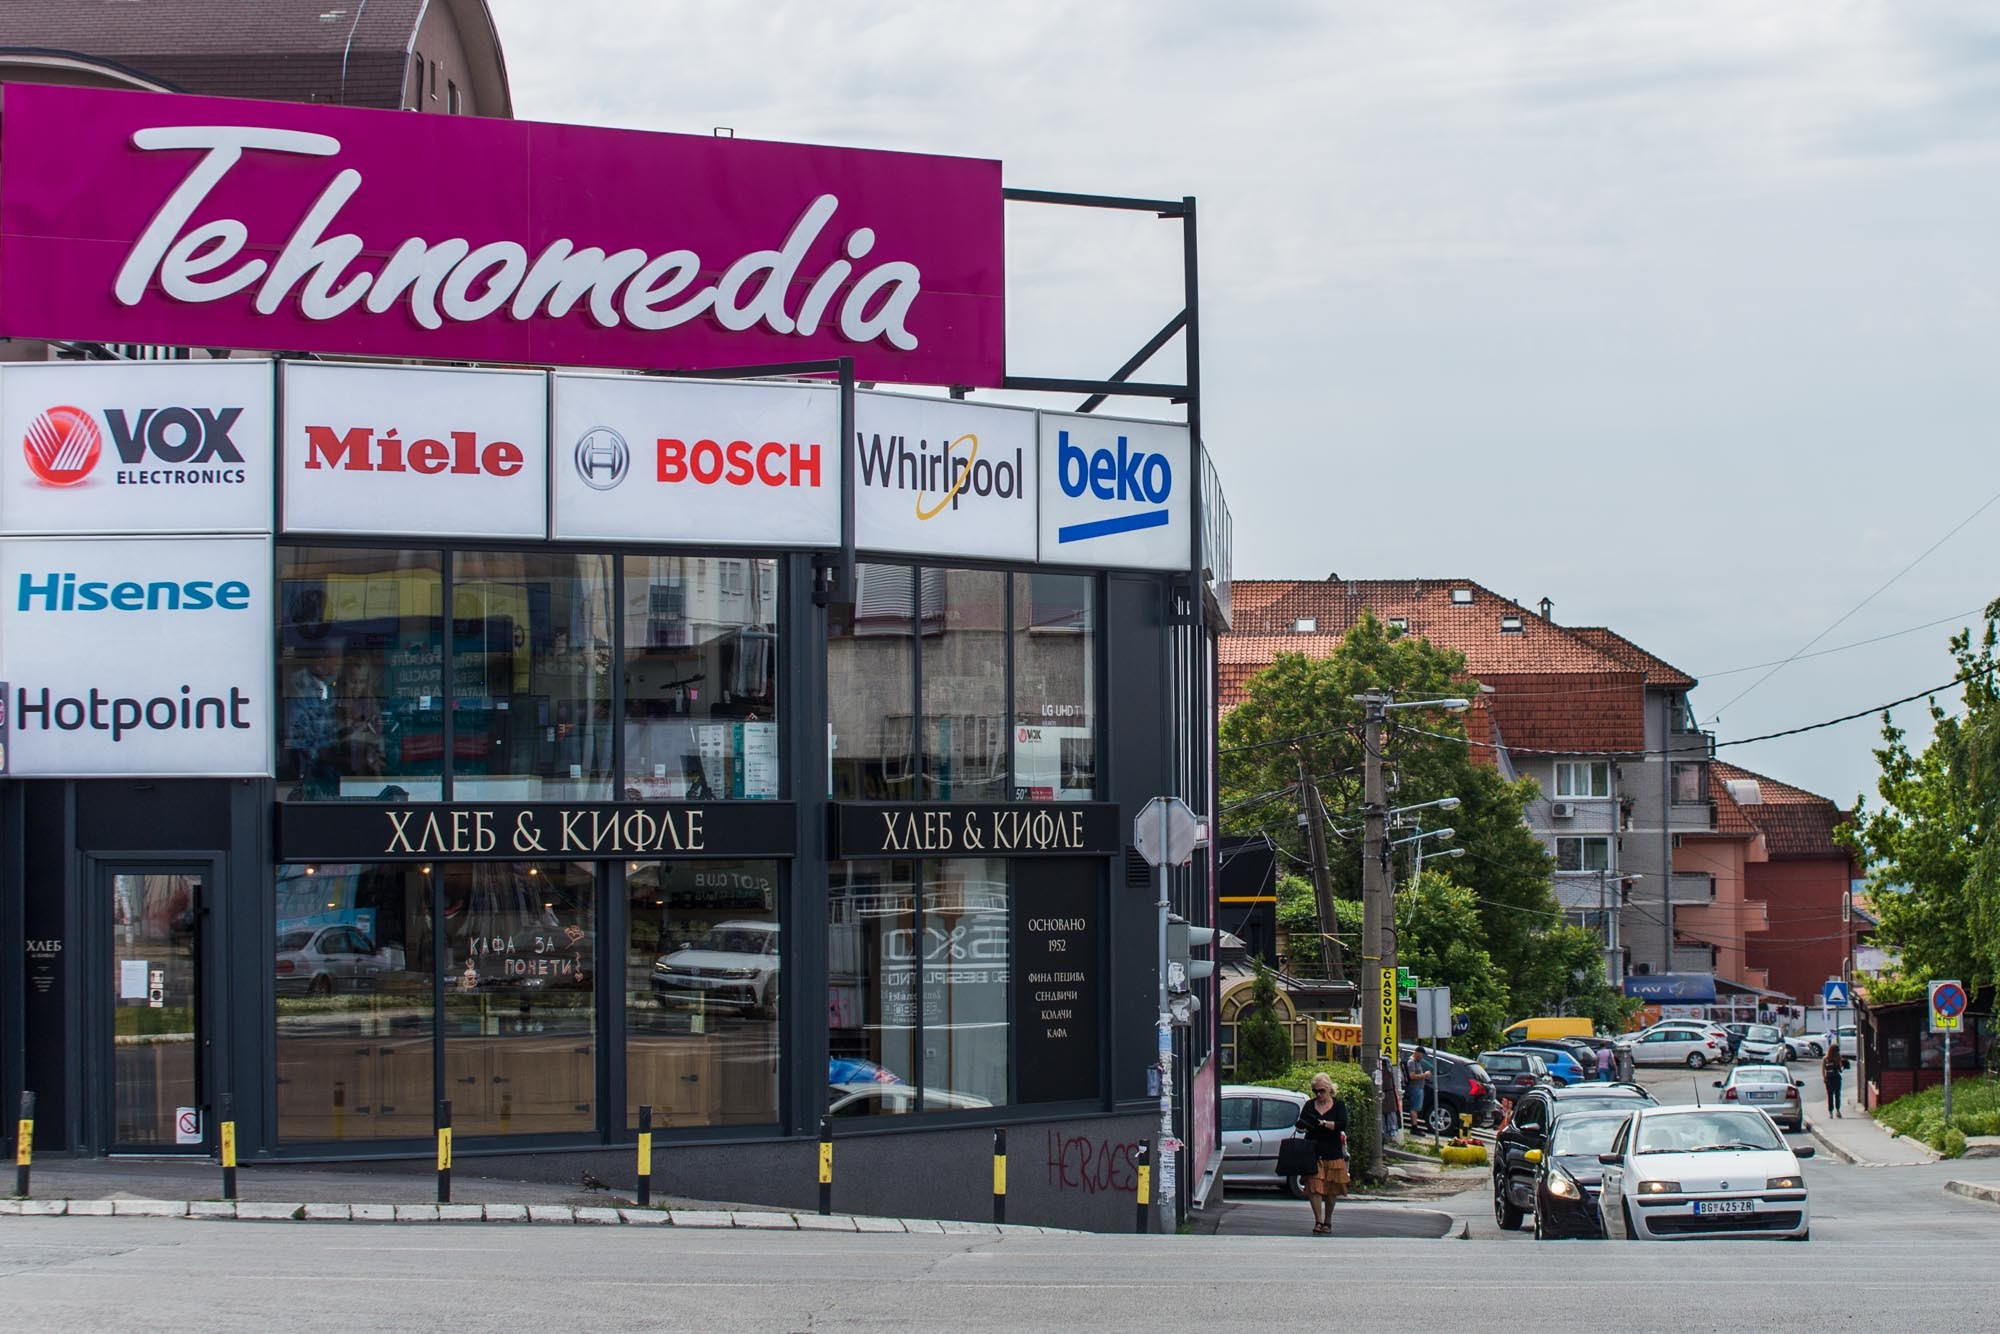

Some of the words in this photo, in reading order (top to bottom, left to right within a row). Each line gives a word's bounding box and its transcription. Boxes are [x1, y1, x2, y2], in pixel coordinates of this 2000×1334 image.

[115, 126, 920, 350] Tehnomedia
[104, 408, 245, 463] VOX
[305, 427, 524, 477] Miele
[656, 438, 821, 487] BOSCH
[857, 432, 1022, 510] Whirlpool
[1058, 430, 1172, 504] beko
[117, 469, 245, 485] ELECTRONICS
[17, 572, 250, 612] Hisense
[18, 685, 250, 742] Hotpoint
[1042, 704, 1053, 716] LG
[1055, 704, 1074, 717] UHD
[385, 811, 496, 853] ХЛЕБ
[512, 811, 548, 852] &
[560, 809, 705, 852] КИФЛЕ
[881, 811, 953, 850] ХЛЕБ
[963, 811, 985, 850] &
[992, 810, 1084, 850] КИФЛЕ
[1028, 918, 1086, 932] ОСНОВАНО
[26, 940, 62, 952] ХЛЕБ
[470, 936, 515, 956] КАФА
[534, 936, 555, 954] ЗА
[1048, 939, 1066, 952] 1952
[1028, 971, 1052, 983] ФИНА
[1053, 970, 1085, 983] ПЕЦИВА
[1035, 990, 1079, 1002] СЕНДВИЧИ
[1041, 1009, 1073, 1020] КОЛАЧИ
[1047, 1027, 1068, 1039] КАФА
[1701, 1201, 1714, 1213] BG
